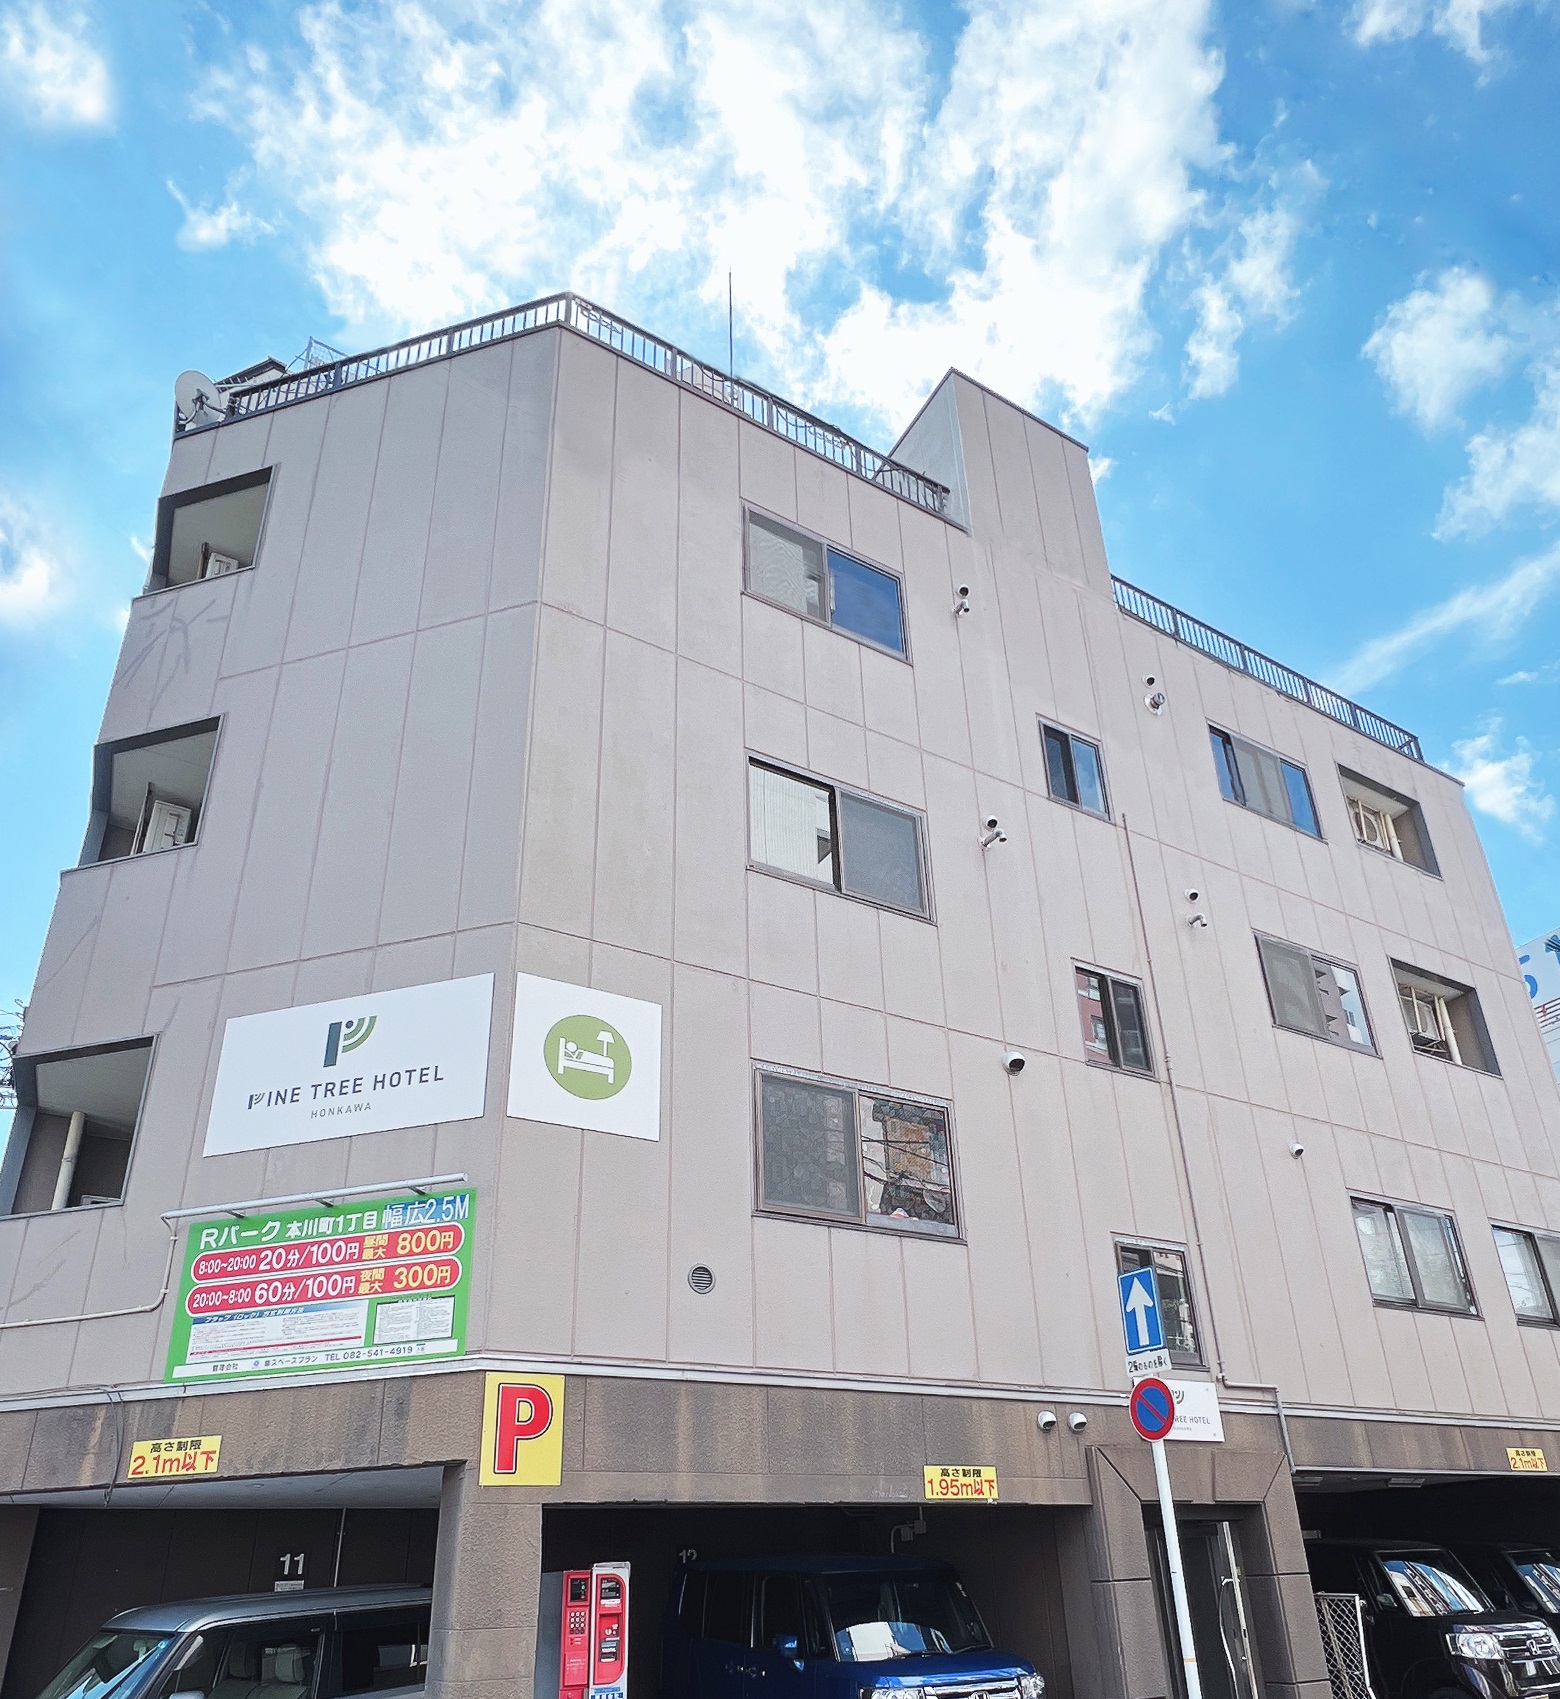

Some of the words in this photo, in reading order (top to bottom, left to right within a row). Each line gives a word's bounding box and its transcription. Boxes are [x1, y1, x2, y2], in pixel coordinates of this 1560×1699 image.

[247, 1086, 301, 1110] PINE
[310, 1076, 364, 1100] TREE
[372, 1065, 445, 1092] HOTEL
[310, 1101, 372, 1119] HONKAWA
[200, 1220, 281, 1250] Rパーク
[285, 1210, 378, 1239] 本川町1丁目
[382, 1193, 470, 1230] 幅広2.5M
[396, 1229, 454, 1255] 800円
[258, 1240, 360, 1271] 20分/100円
[362, 1247, 387, 1260] 最大
[360, 1267, 385, 1282] 夜間
[393, 1263, 451, 1289] 300円
[254, 1273, 357, 1304] 60分/100円
[357, 1281, 383, 1294] 最大
[325, 1352, 340, 1362] TEL
[343, 1345, 414, 1360] 082-541-4919
[494, 1383, 554, 1475] P
[1189, 1416, 1211, 1425] HOTEL
[149, 1439, 202, 1454] 高さ制限
[131, 1449, 217, 1476] 2.1m以下
[927, 1478, 995, 1497] 1.95m以下
[280, 1553, 305, 1575] 11
